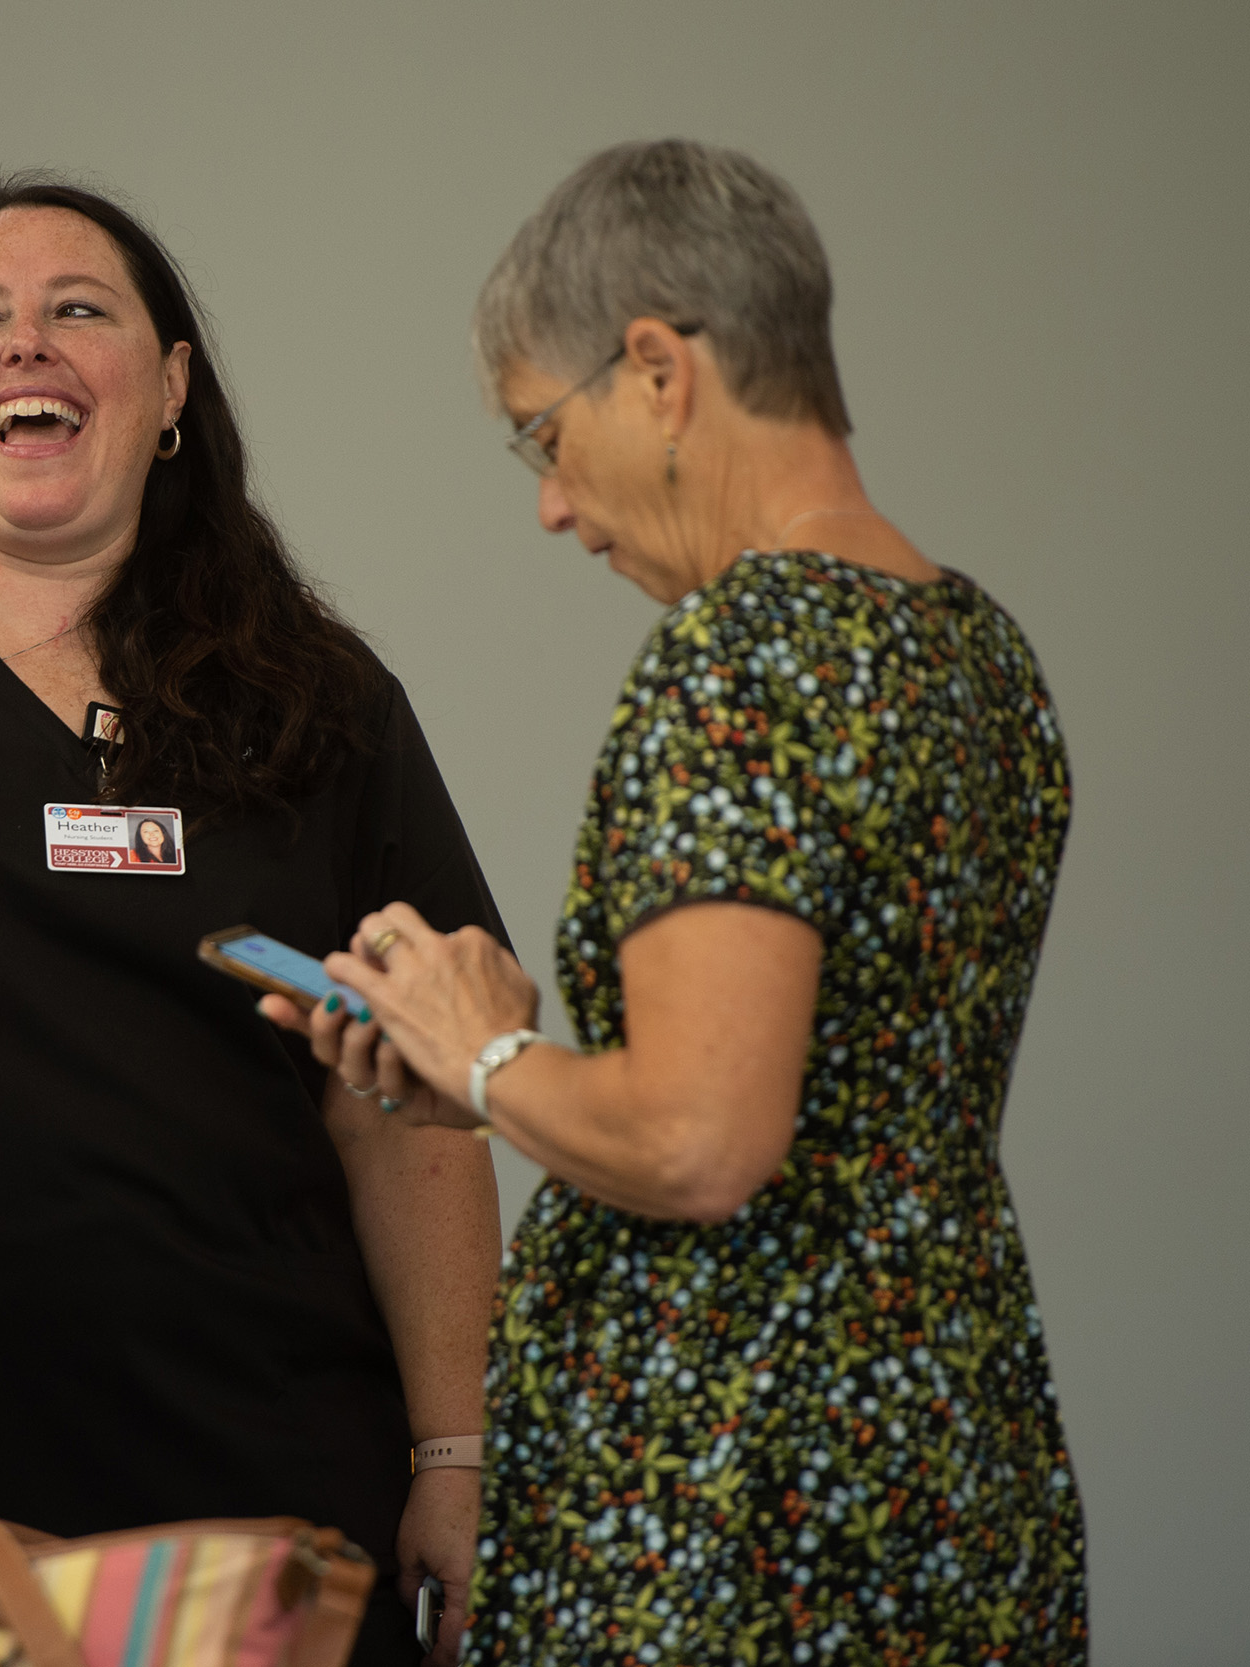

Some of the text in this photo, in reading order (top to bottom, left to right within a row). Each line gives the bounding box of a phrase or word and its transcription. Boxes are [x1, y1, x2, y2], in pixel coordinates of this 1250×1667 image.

[58, 821, 118, 832] Heather
[54, 849, 109, 857] HESSTON
[54, 855, 110, 863] COLLEGE
